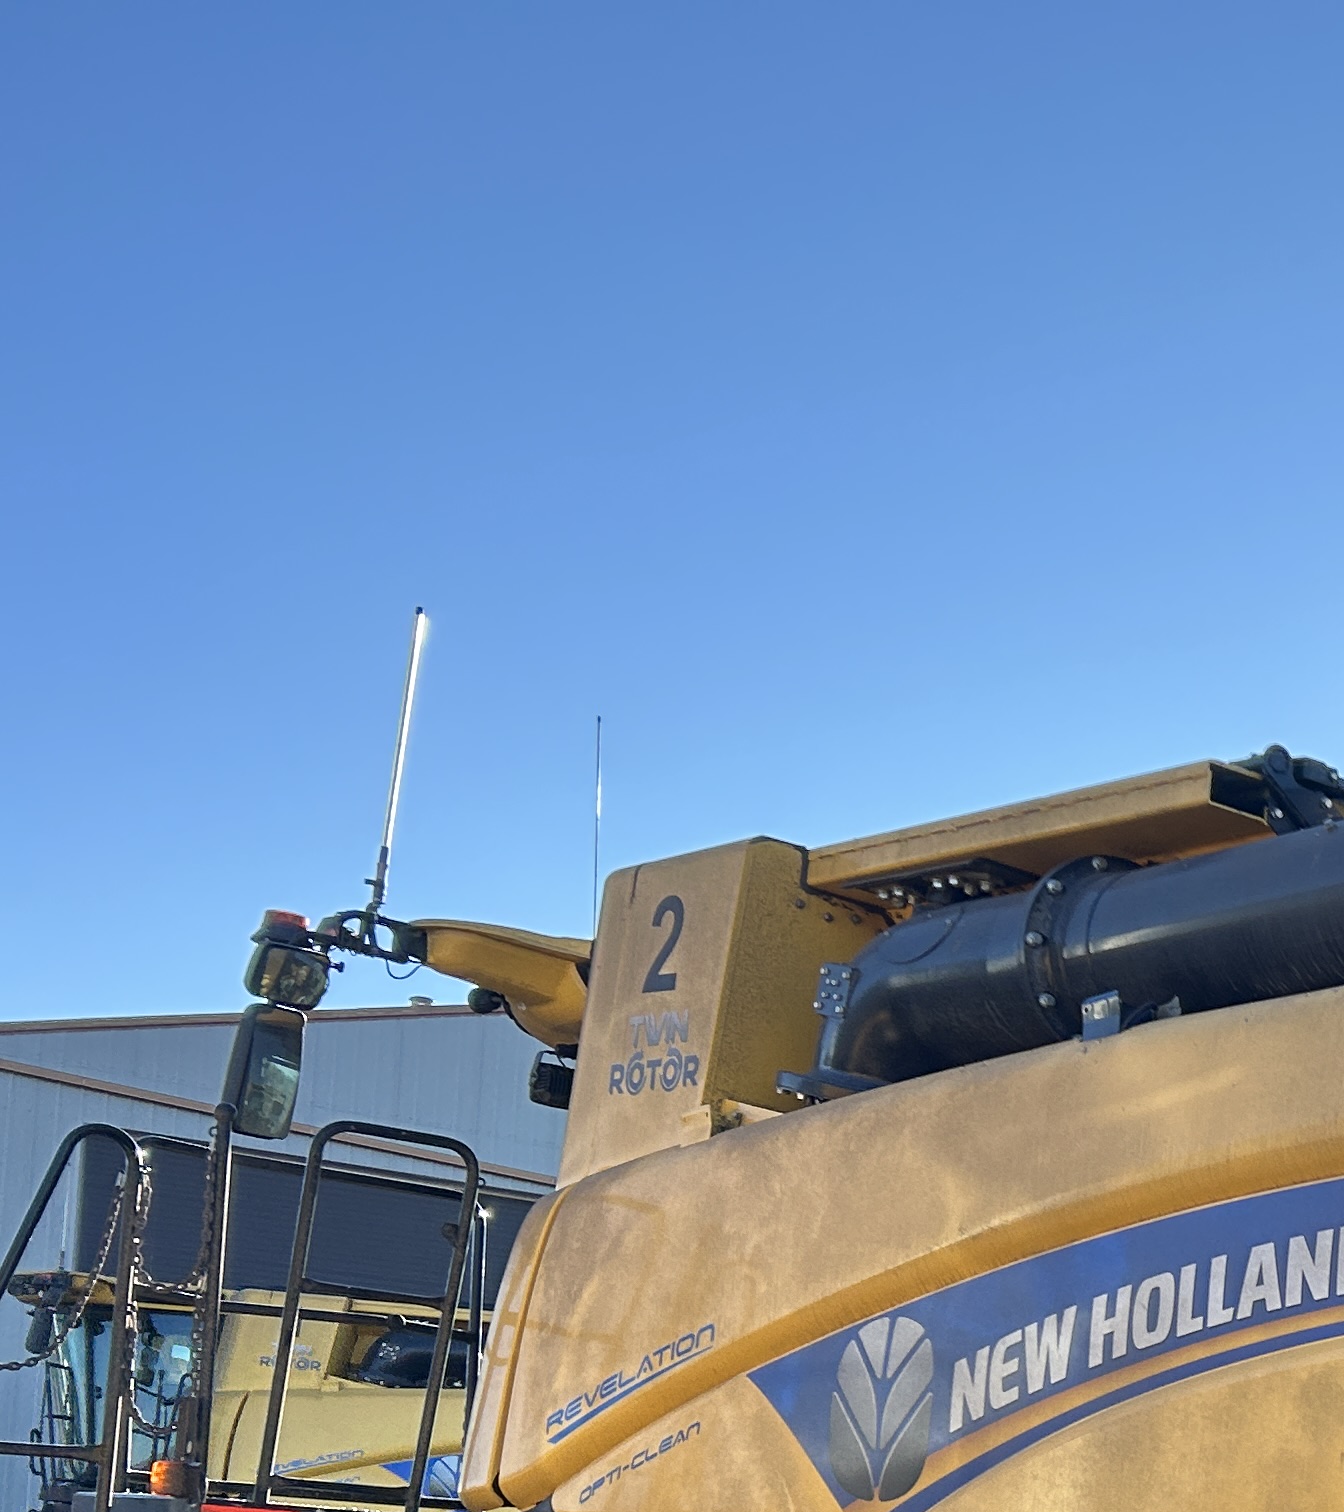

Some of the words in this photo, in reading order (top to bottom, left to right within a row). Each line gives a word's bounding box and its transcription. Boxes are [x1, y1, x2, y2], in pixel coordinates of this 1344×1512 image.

[641, 894, 685, 994] 2
[608, 1048, 700, 1096] ROTOR
[545, 1323, 716, 1436] REVELATION
[948, 1304, 1079, 1434] NEW
[578, 1421, 701, 1505] OPTI-CLEAN
